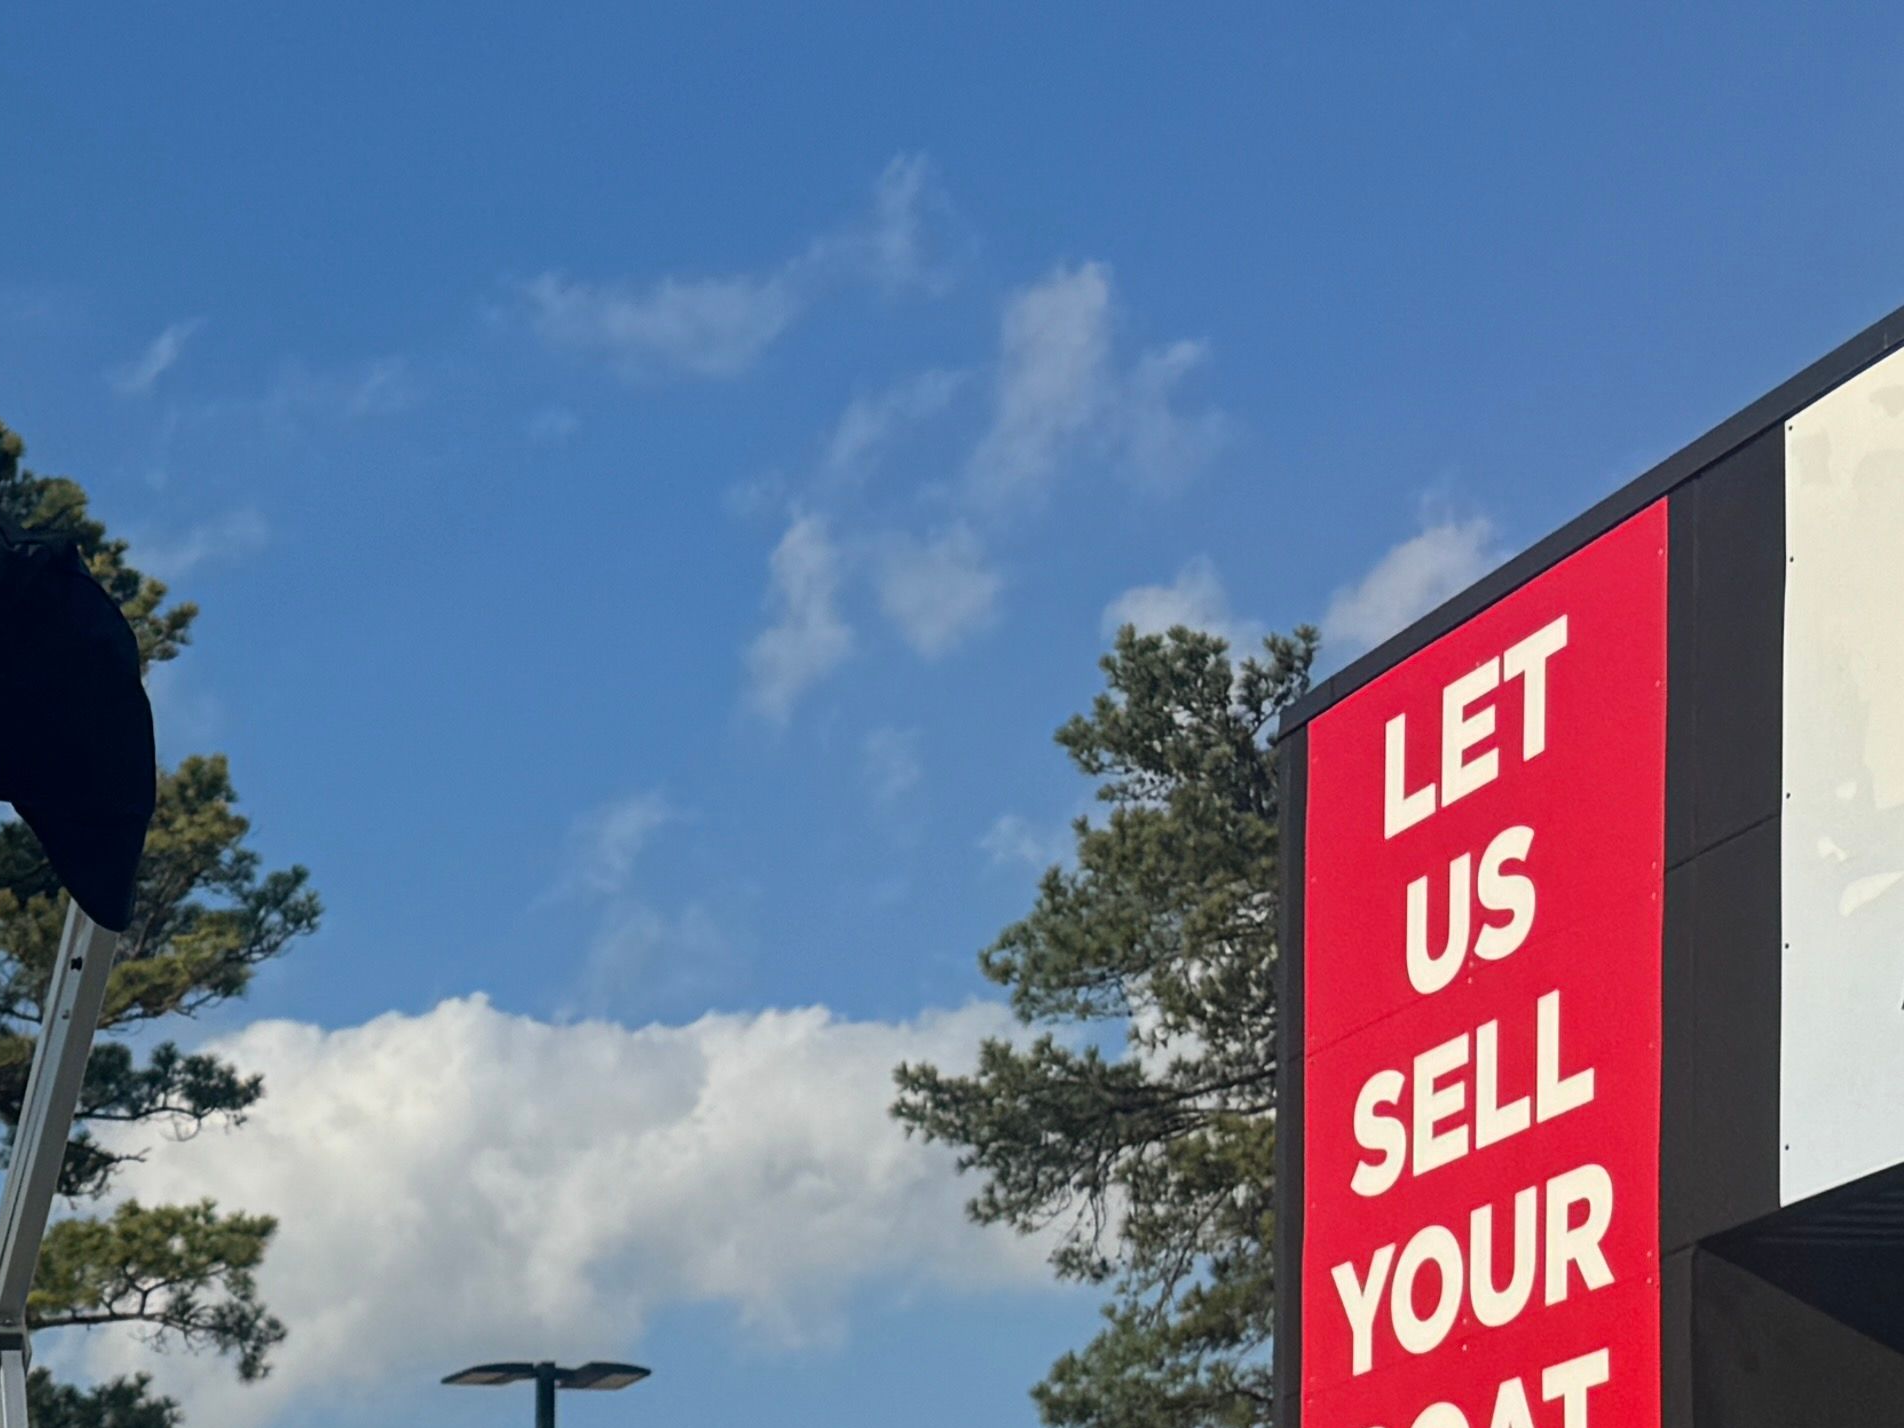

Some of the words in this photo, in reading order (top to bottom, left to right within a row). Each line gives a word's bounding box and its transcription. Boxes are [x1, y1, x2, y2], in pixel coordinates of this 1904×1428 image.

[1384, 614, 1568, 840] LET
[1406, 825, 1536, 994] US
[1350, 989, 1595, 1197] SELL
[1331, 1164, 1615, 1376] YOUR
